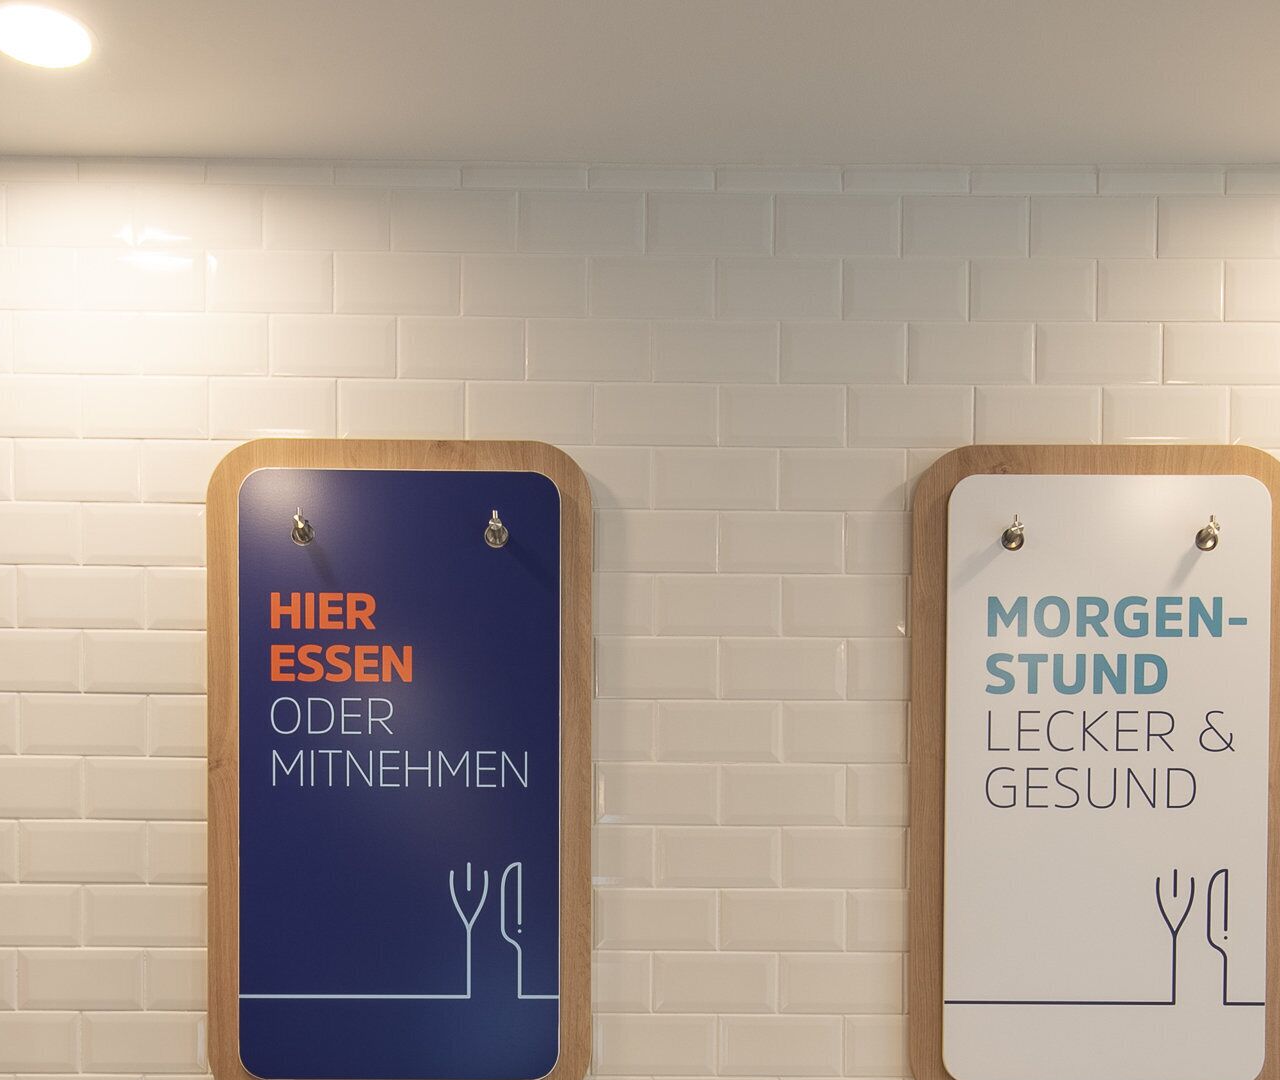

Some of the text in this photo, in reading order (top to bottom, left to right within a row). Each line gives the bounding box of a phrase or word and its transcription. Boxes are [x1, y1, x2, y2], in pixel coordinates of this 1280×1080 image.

[271, 592, 375, 629] HIER
[988, 596, 1247, 638] MORGEN-
[271, 645, 412, 682] ESSEN
[986, 653, 1168, 695] STUND
[271, 697, 393, 734] ODER
[988, 710, 1235, 752] LECKER &
[273, 750, 527, 787] MITNEHMEN
[986, 767, 1196, 808] GESUND
